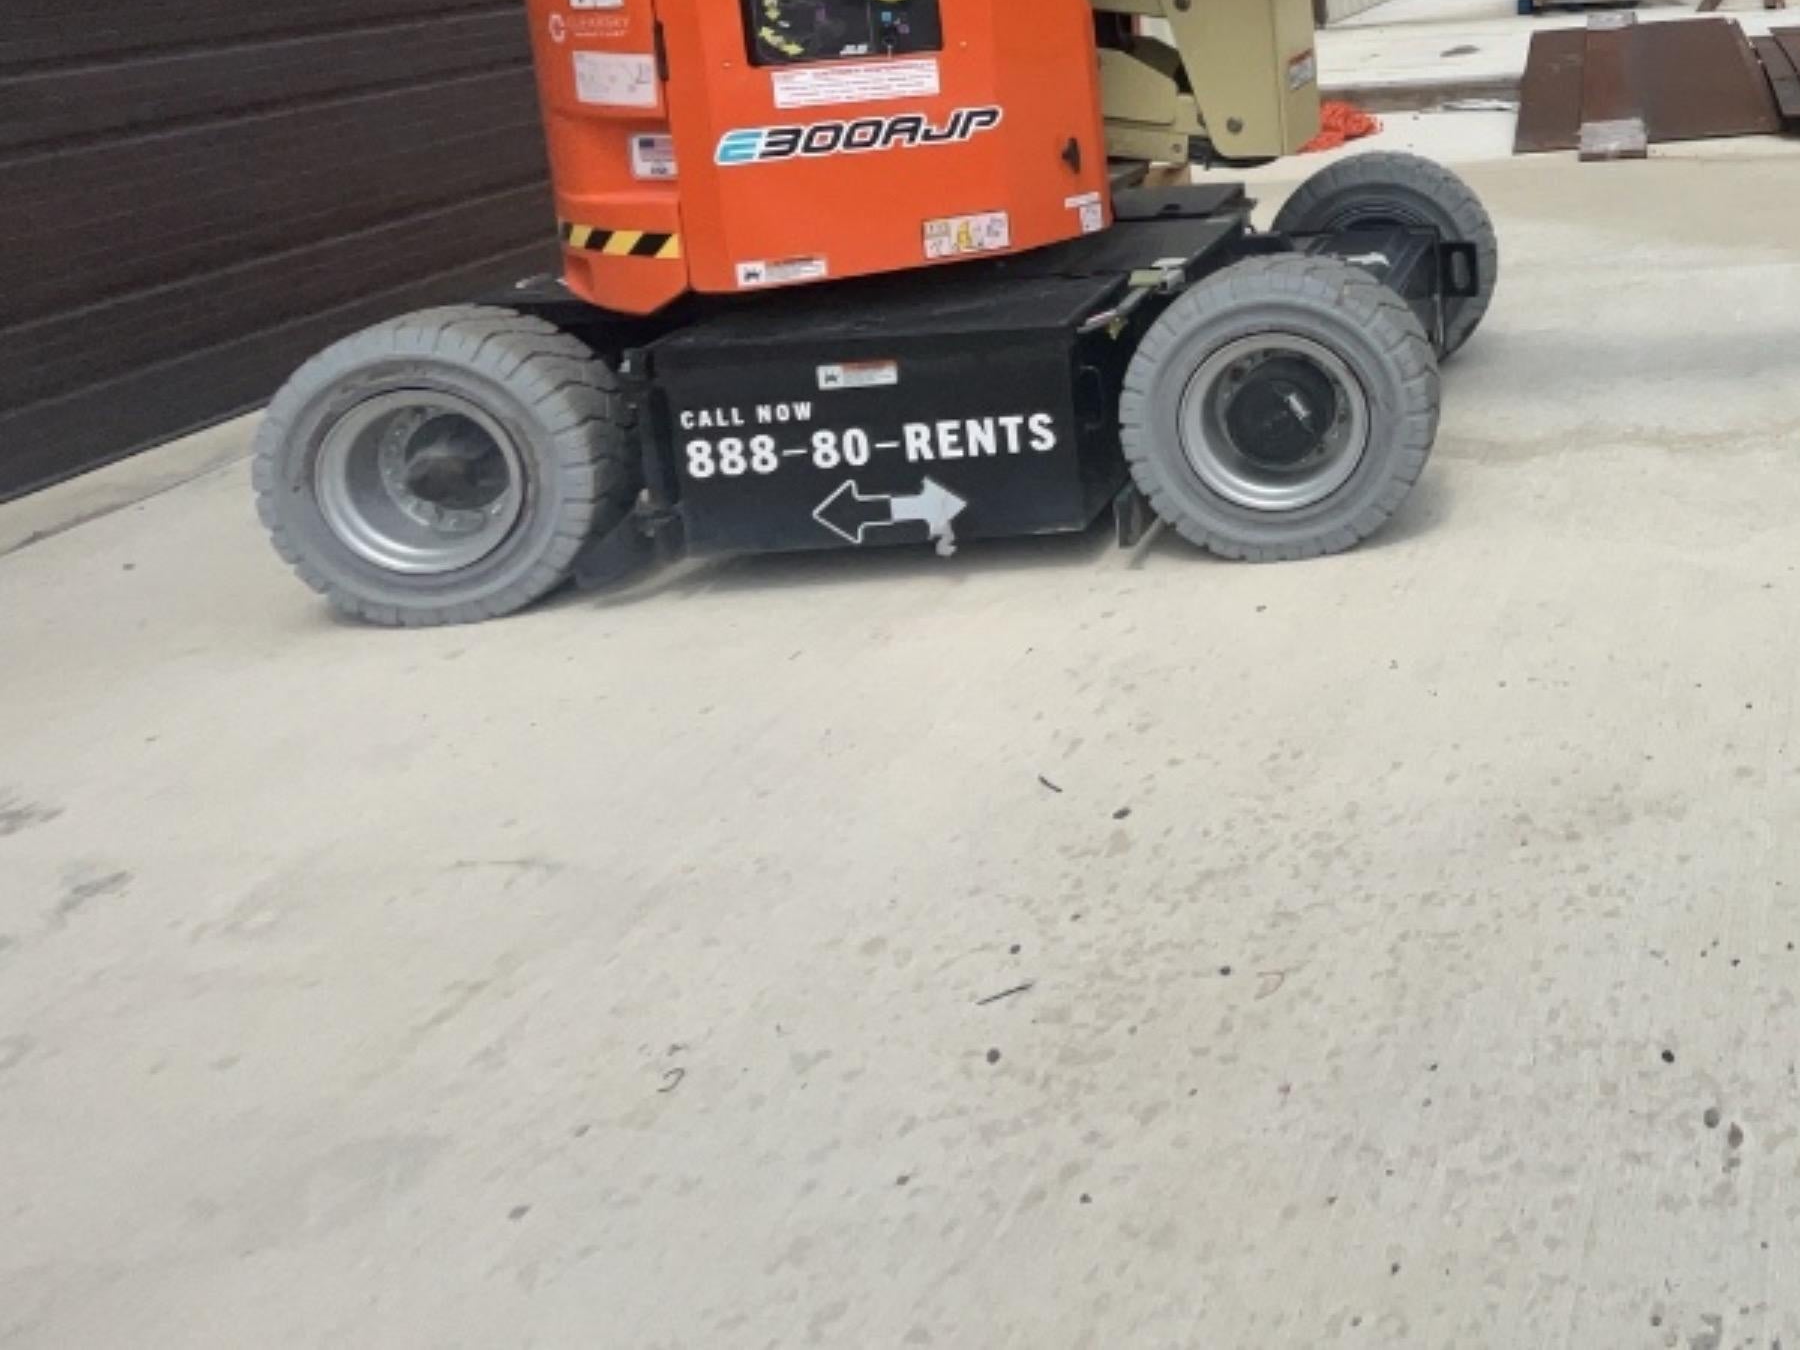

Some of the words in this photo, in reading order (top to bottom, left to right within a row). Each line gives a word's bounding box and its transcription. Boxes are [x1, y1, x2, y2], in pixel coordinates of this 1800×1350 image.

[715, 106, 1003, 166] E300AJP
[680, 407, 744, 430] CALL
[756, 401, 812, 424] NOW
[686, 412, 1057, 478] 888-80-RENTS
